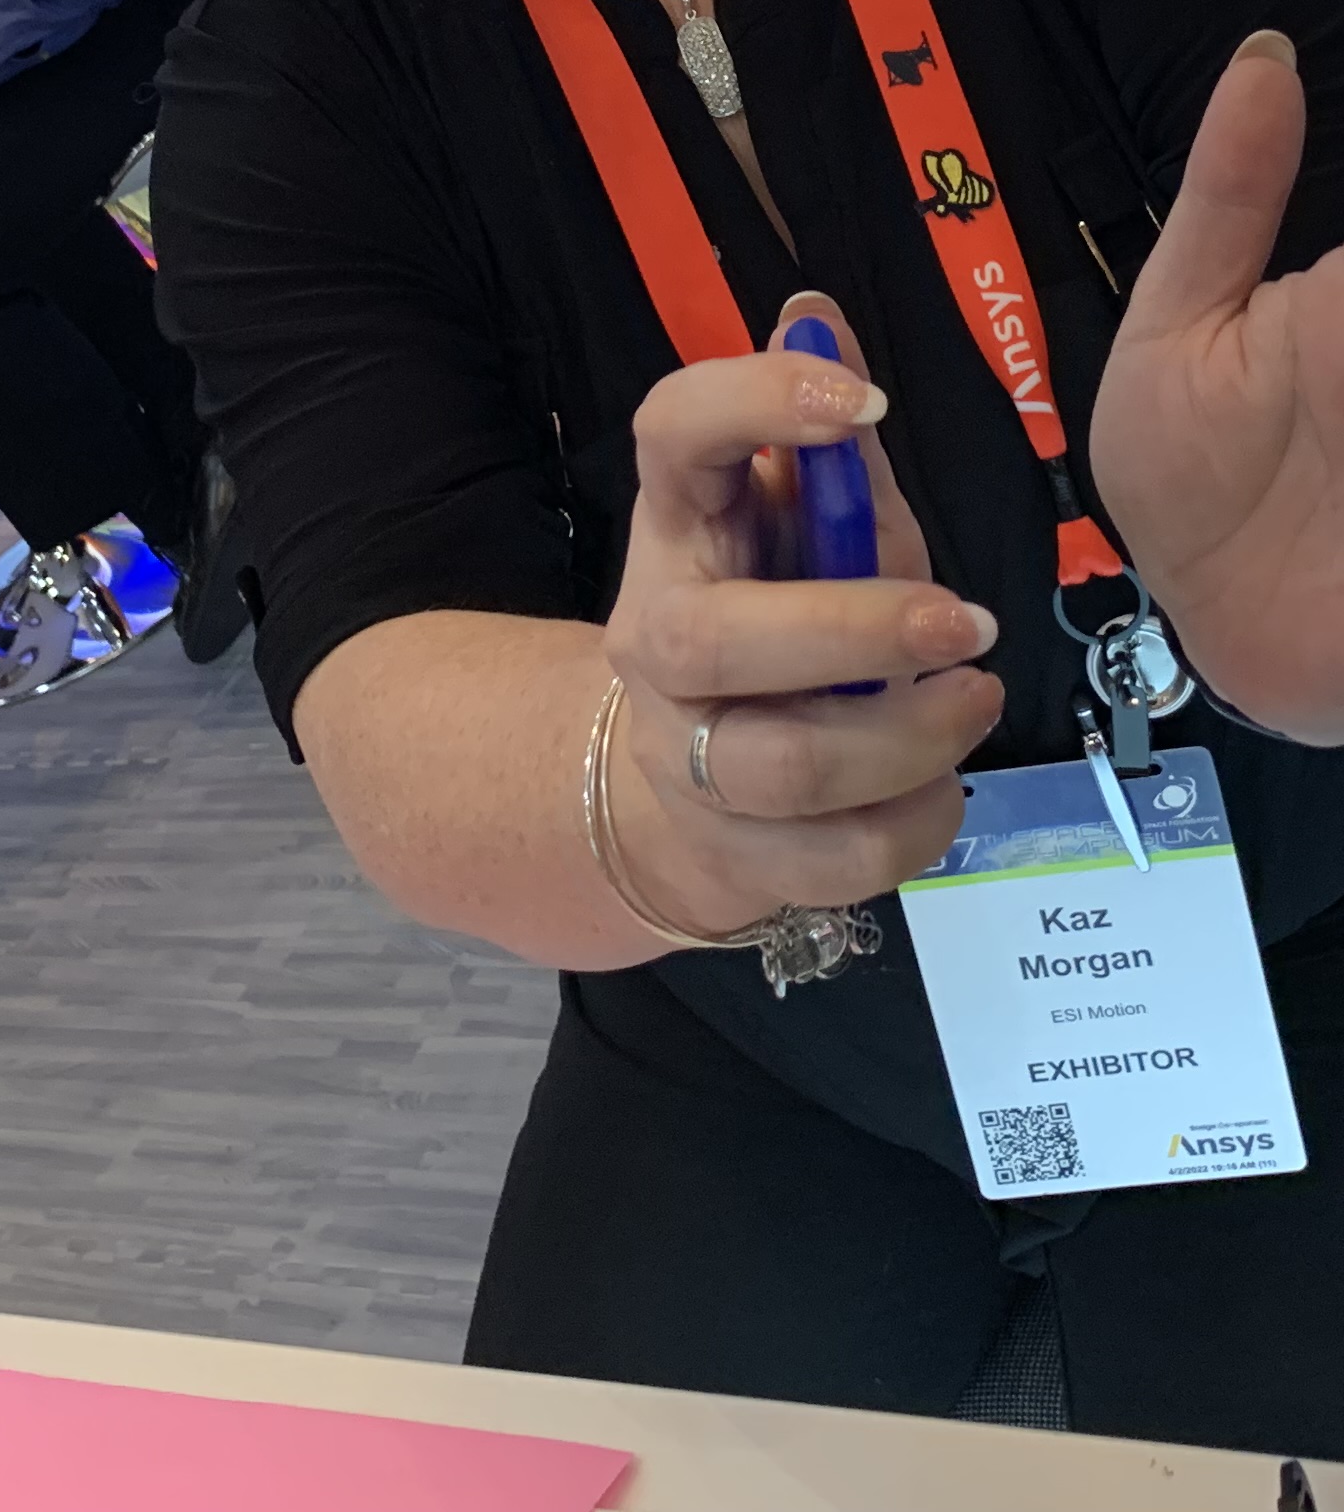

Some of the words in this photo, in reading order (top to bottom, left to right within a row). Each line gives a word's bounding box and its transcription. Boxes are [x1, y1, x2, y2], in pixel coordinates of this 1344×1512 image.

[973, 260, 1053, 415] Ansys
[1039, 906, 1112, 934] Kaz
[1018, 947, 1154, 980] Morgan
[1051, 1007, 1082, 1024] ESI
[1087, 1000, 1148, 1022] Motion
[1027, 1047, 1199, 1083] EXHIBITOR
[1167, 1133, 1275, 1158] Ansys
[1239, 1160, 1257, 1170] AM
